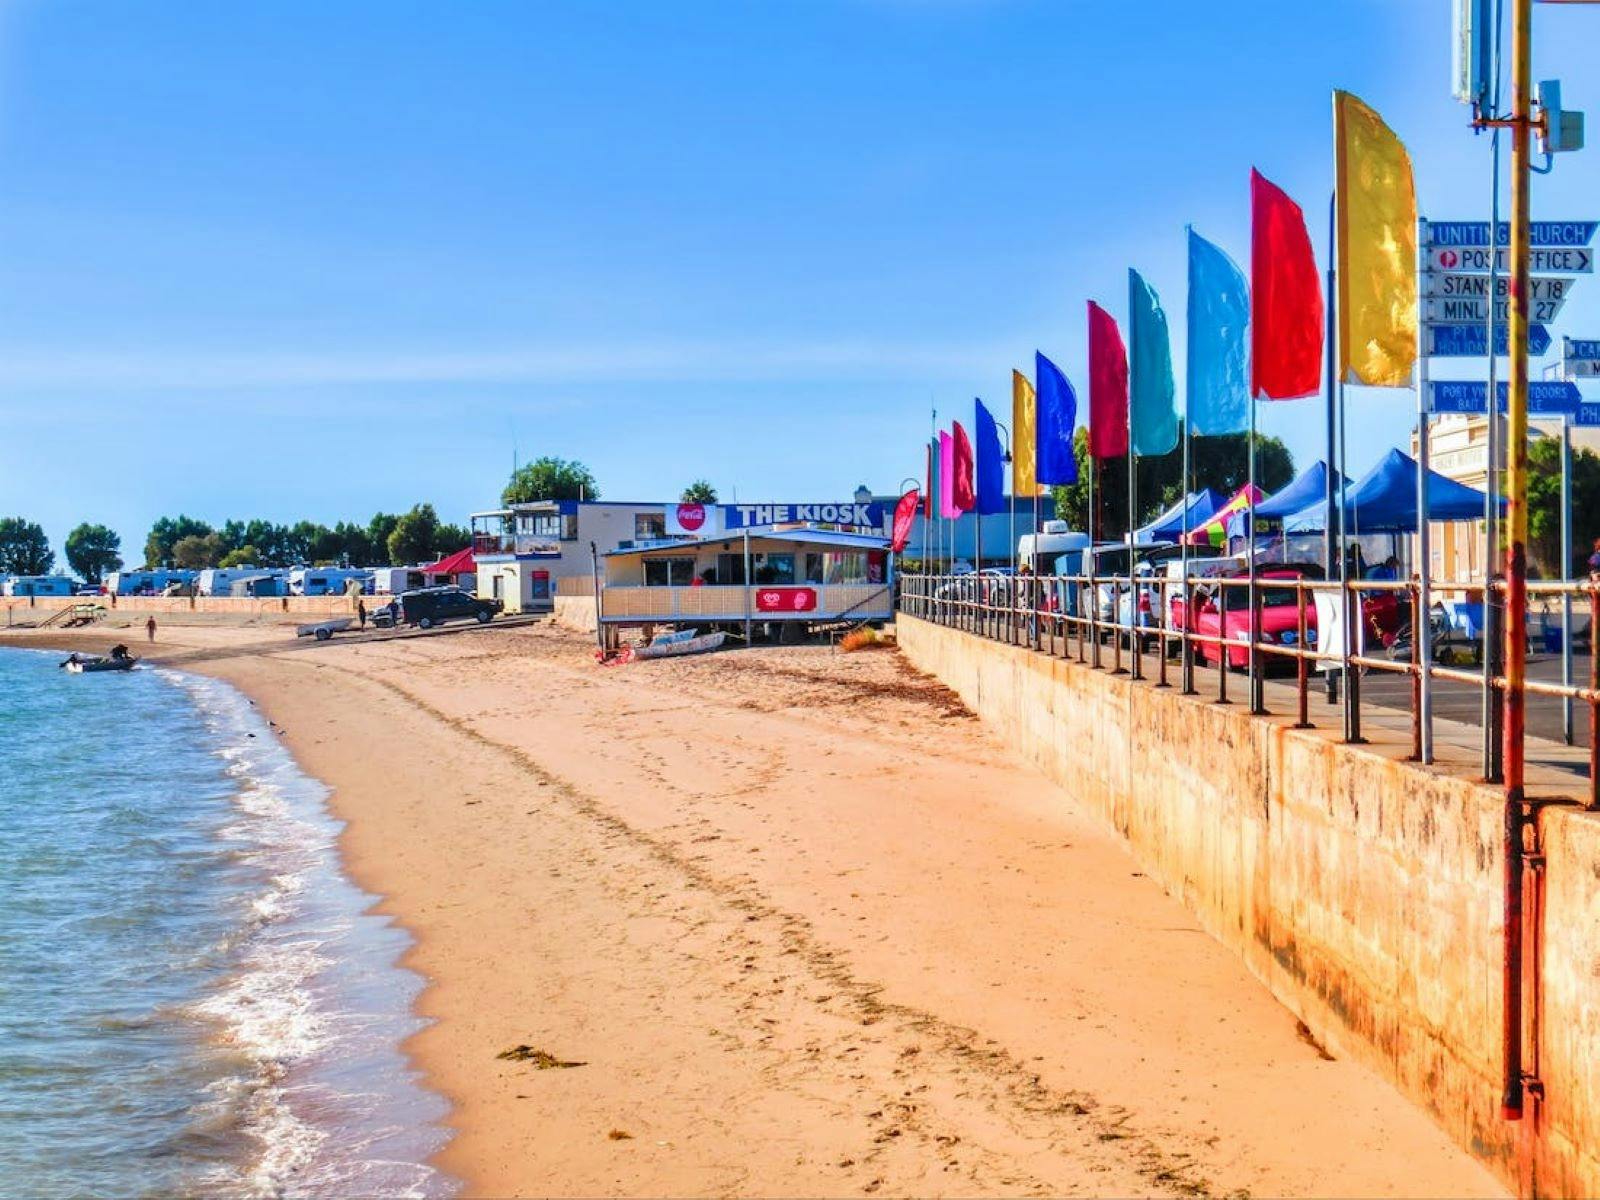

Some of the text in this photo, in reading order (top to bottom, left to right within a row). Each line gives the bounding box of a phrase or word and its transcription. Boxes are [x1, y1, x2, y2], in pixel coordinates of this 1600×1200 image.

[1527, 225, 1586, 244] HURCH
[1462, 250, 1573, 270] POST FICE
[1443, 276, 1563, 299] STANBY 18
[1535, 301, 1557, 320] 27
[736, 504, 872, 526] THE KIOSK
